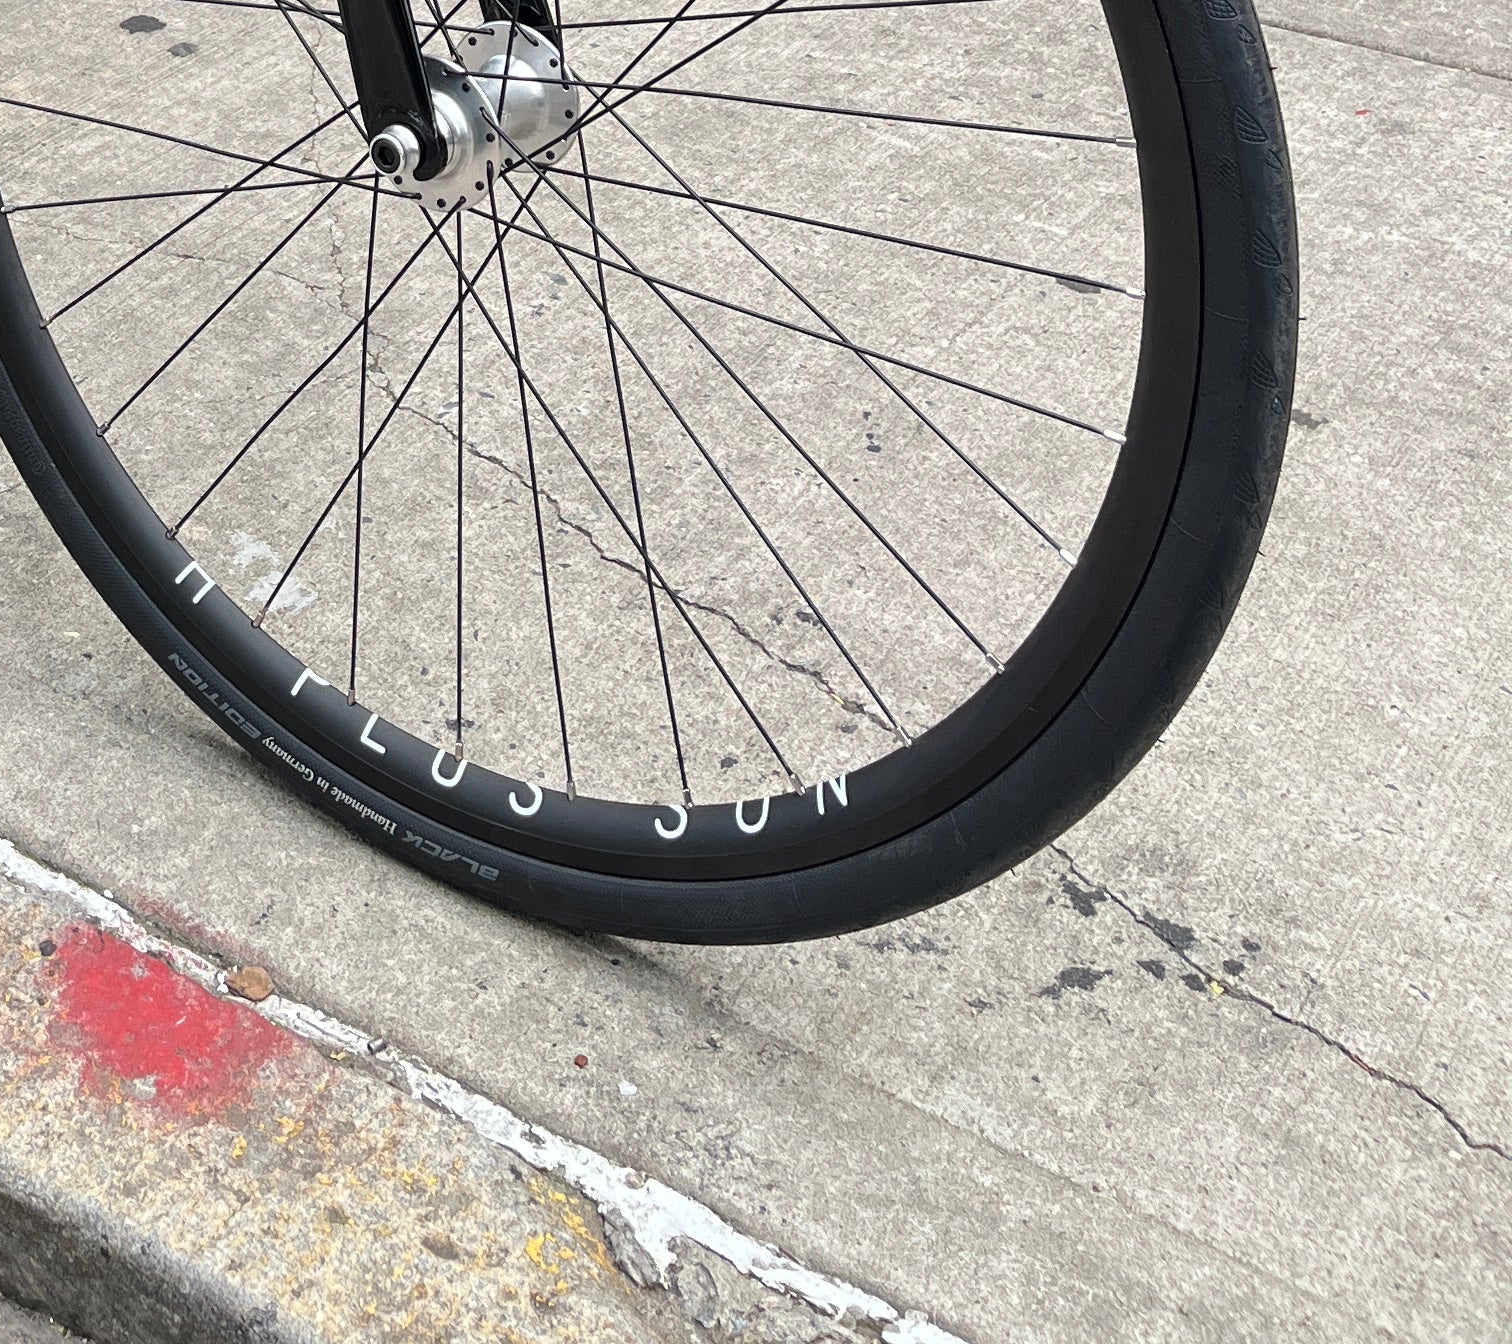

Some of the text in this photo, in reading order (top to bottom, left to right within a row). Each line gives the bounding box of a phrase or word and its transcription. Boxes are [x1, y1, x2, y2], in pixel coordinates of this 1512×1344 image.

[167, 651, 501, 882] BLACK Handmade in Germany EDITION
